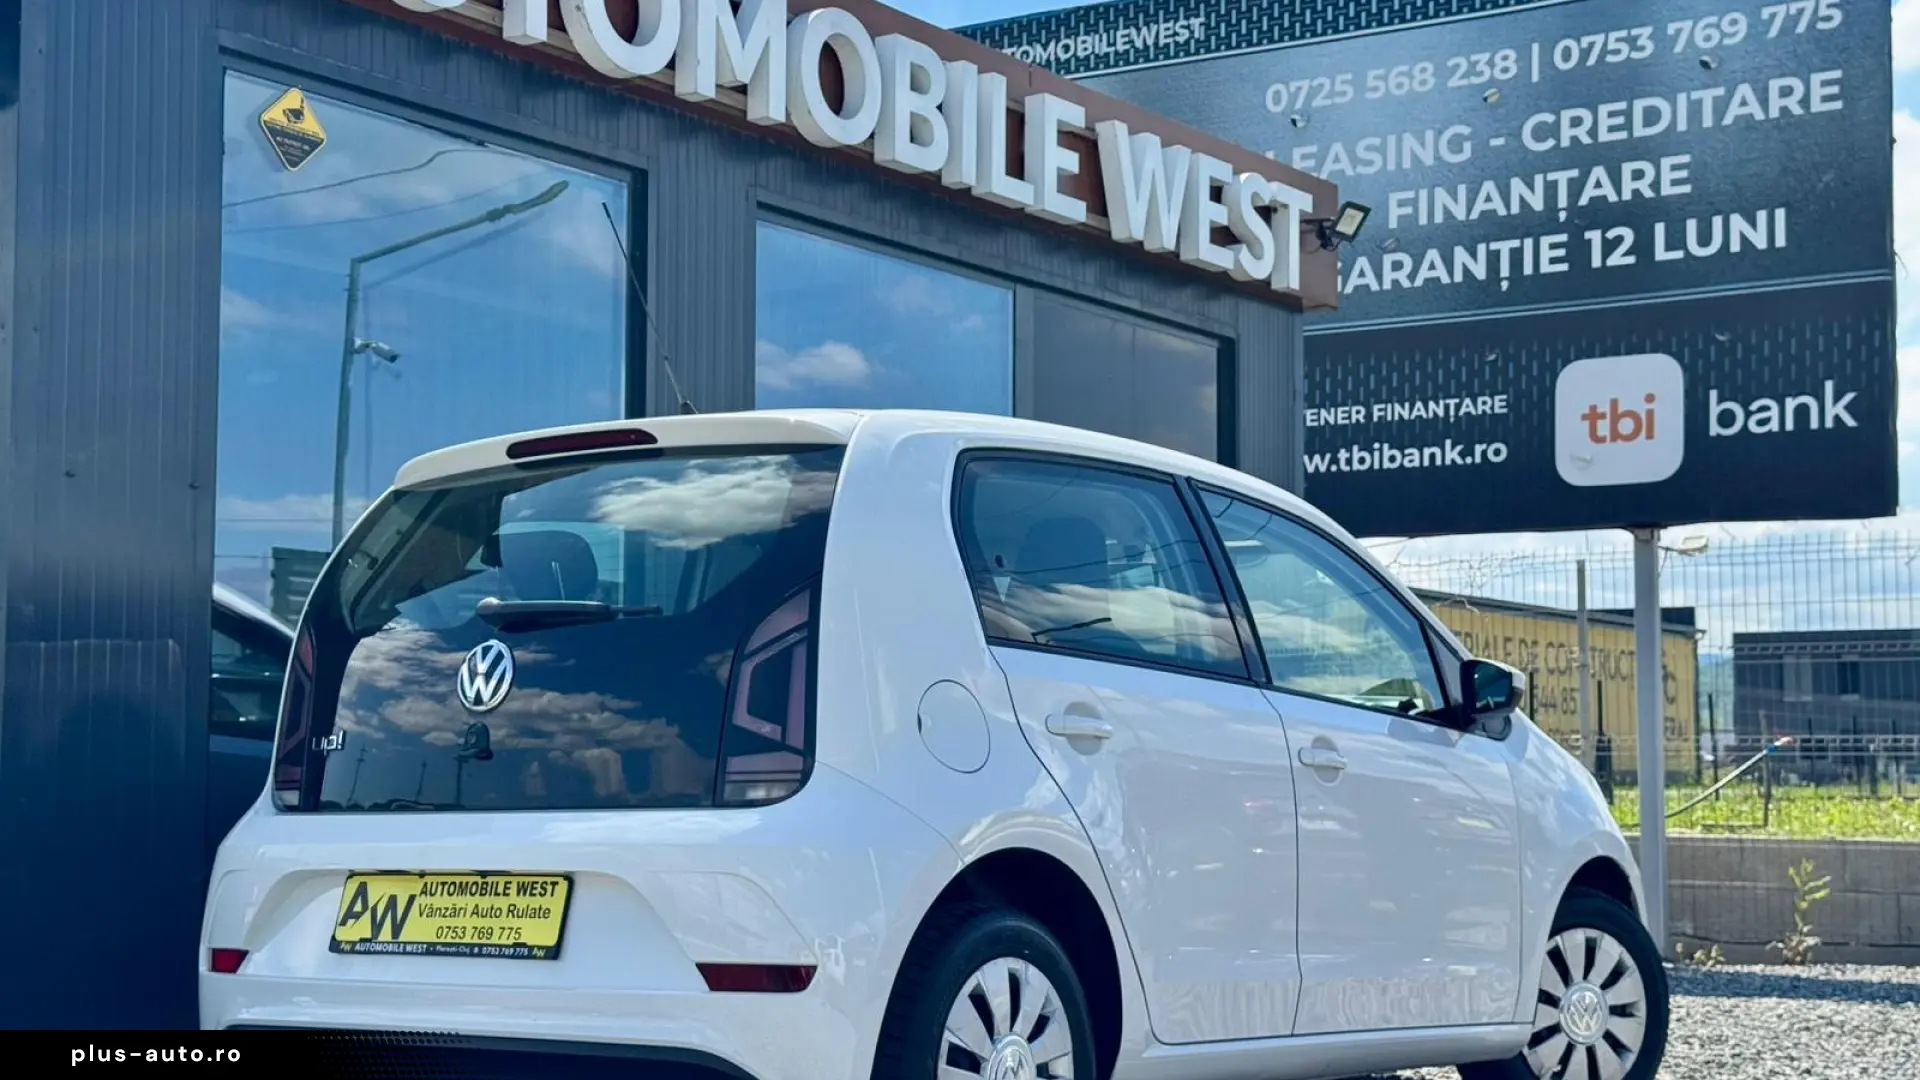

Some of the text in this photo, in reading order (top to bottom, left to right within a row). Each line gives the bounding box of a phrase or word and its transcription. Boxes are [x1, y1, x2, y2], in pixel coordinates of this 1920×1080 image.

[1265, 72, 1354, 113] 0725
[1364, 61, 1436, 99] 568
[1446, 49, 1518, 88] 238
[1552, 26, 1655, 71] 0753
[1667, 11, 1748, 54] 769
[1760, 0, 1843, 39] 775
[1265, 125, 1473, 180] EASING
[1521, 69, 1844, 152] CREDITARE
[391, 0, 1314, 295] OMOBILE WEST
[1387, 154, 1693, 229] FINANȚARE
[1337, 207, 1787, 292] ARANȚIE 12 LUNI
[1303, 394, 1508, 427] ENER FINANȚARE
[1580, 392, 1656, 444] tbi
[1708, 379, 1859, 437] bank
[1303, 438, 1508, 474] w.tbibank.ro
[311, 729, 344, 757] up!
[419, 881, 559, 898] AUTOMOBILE WEST
[469, 904, 503, 919] Auto
[505, 903, 552, 920] Rulate
[354, 942, 404, 953] AUTOMOBILE
[405, 943, 428, 953] WEST
[435, 925, 523, 941] 0753 769 775
